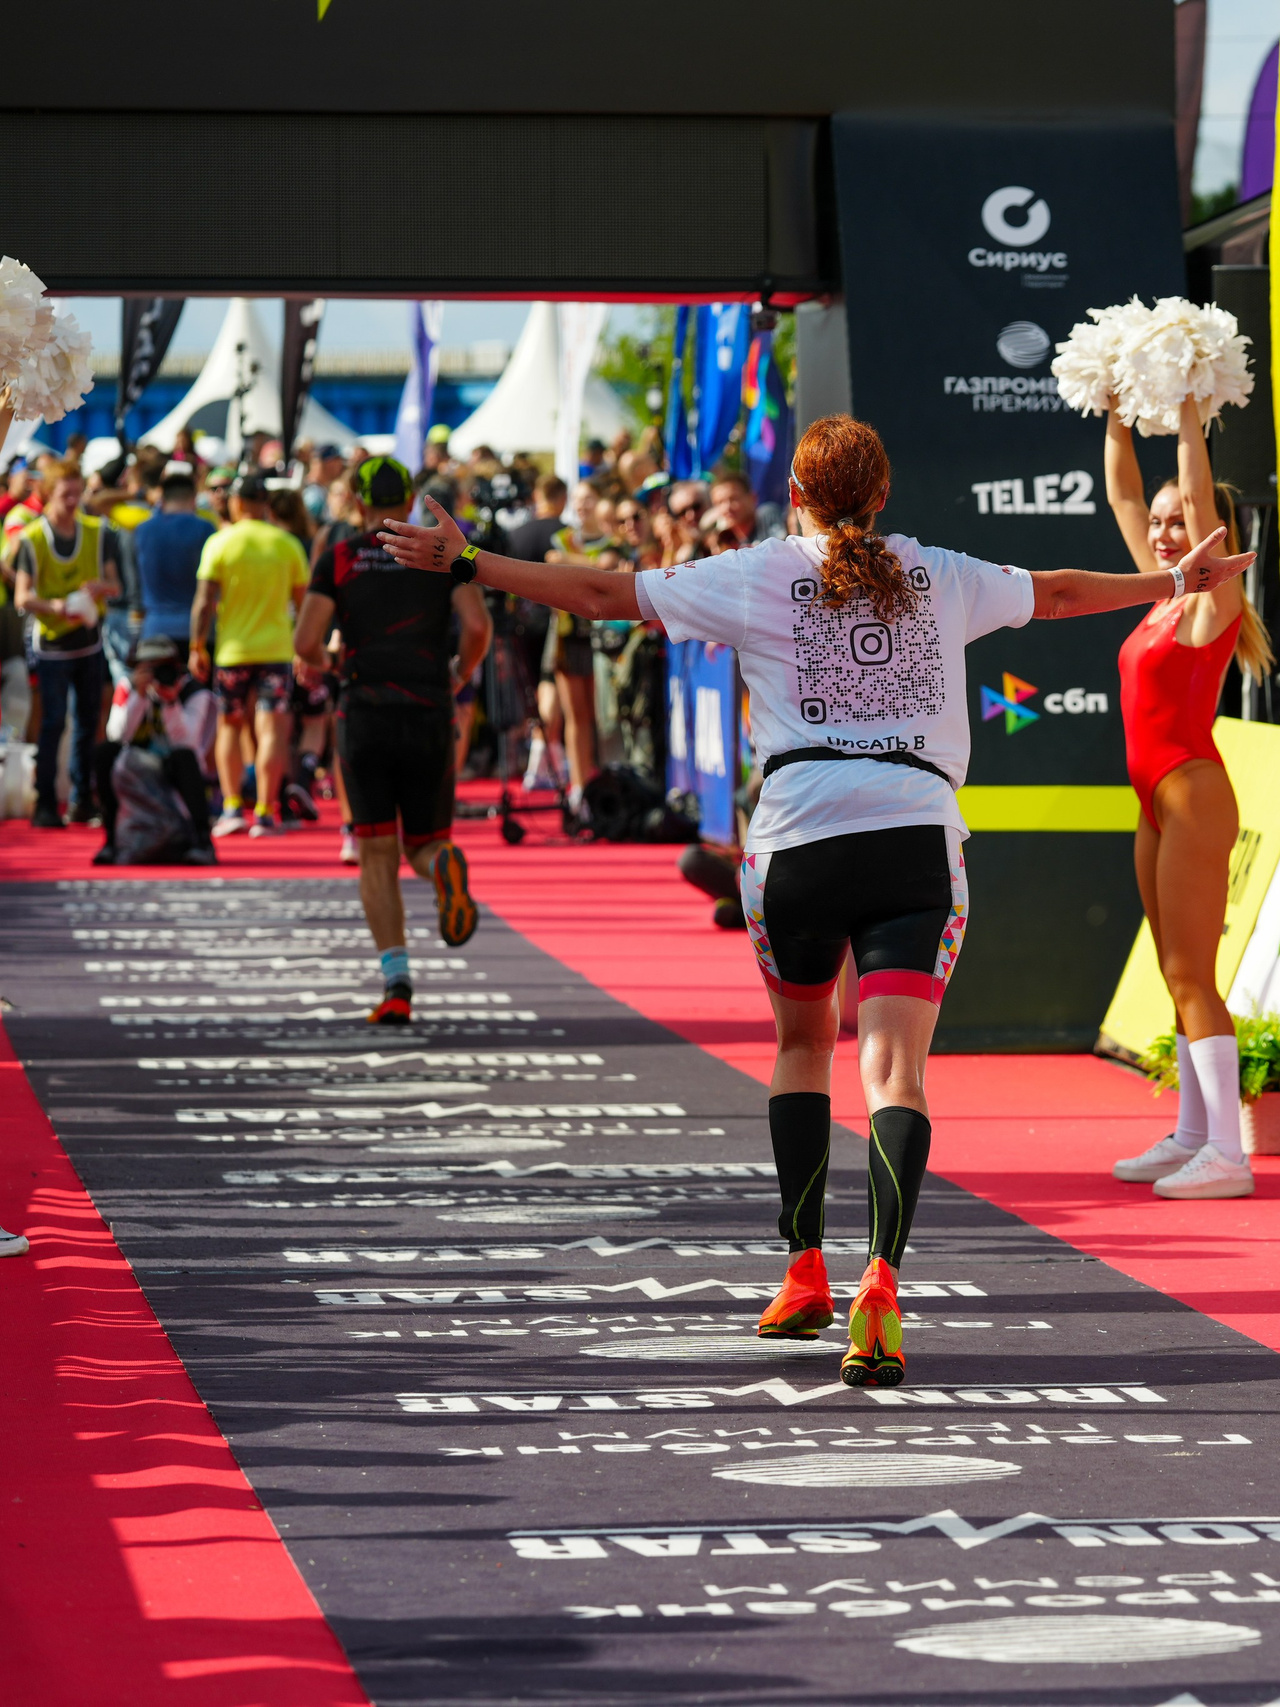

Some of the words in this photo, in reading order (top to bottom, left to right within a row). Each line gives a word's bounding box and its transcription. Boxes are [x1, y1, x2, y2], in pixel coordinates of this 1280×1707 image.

[968, 247, 1068, 272] Сириус
[972, 470, 1096, 515] TELE2
[1044, 687, 1109, 714] сбп
[282, 1248, 546, 1263] STAR
[316, 1289, 592, 1305] STAR
[398, 1394, 714, 1412] STAR
[864, 1387, 1168, 1404] IRON
[509, 1531, 882, 1559] STAR
